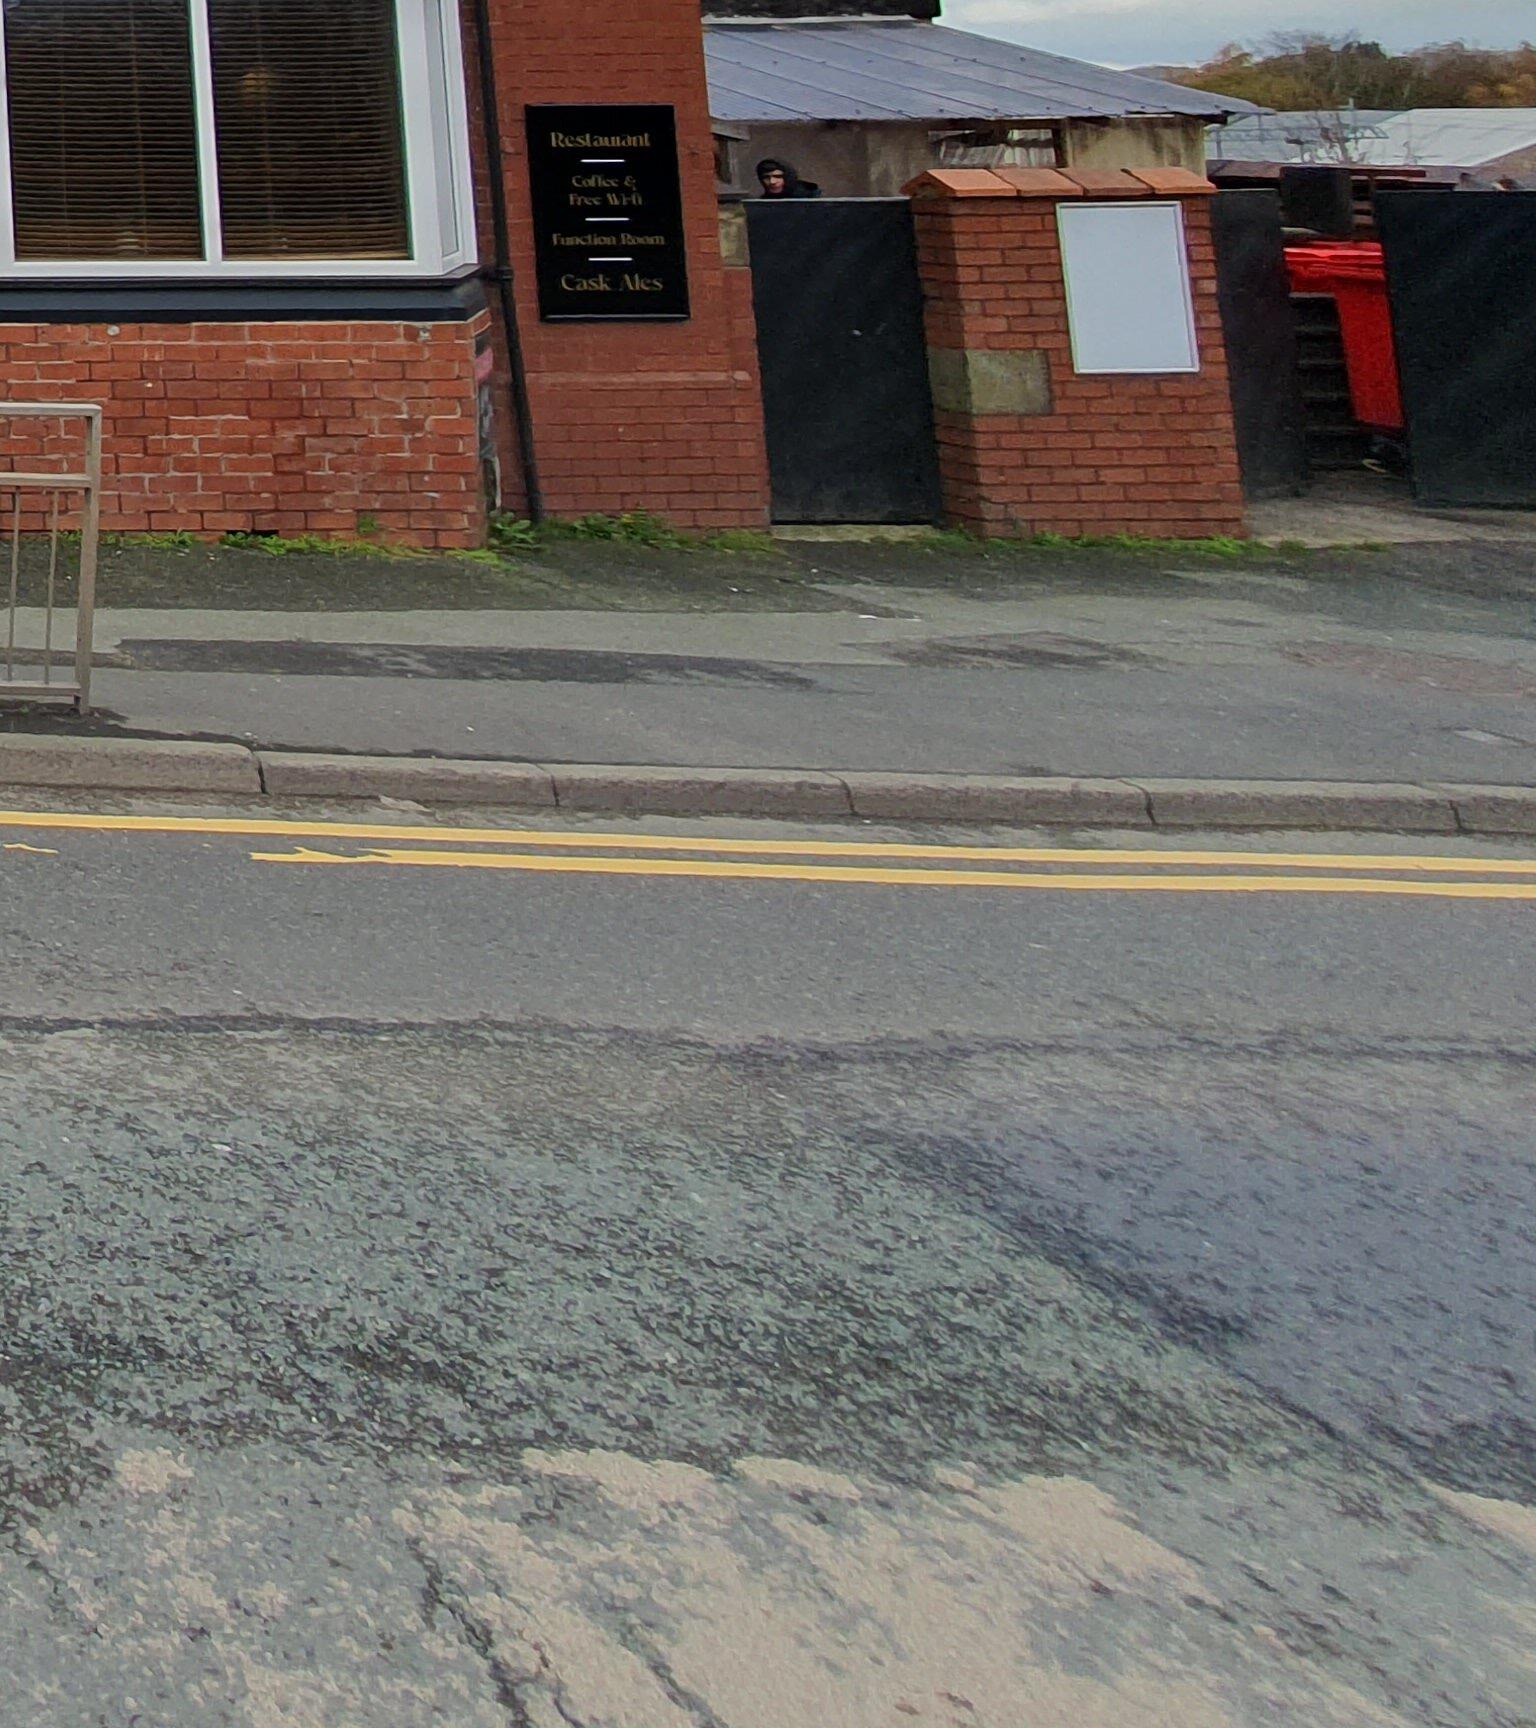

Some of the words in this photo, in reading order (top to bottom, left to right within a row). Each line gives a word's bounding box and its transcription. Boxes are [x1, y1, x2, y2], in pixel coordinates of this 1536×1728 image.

[550, 131, 651, 148] Restaurant
[571, 174, 619, 188] Coffee
[624, 175, 637, 191] &
[568, 192, 603, 206] Free
[552, 232, 617, 247] Function
[621, 233, 666, 246] Room
[561, 273, 612, 292] Cask
[619, 273, 664, 292] Ales
